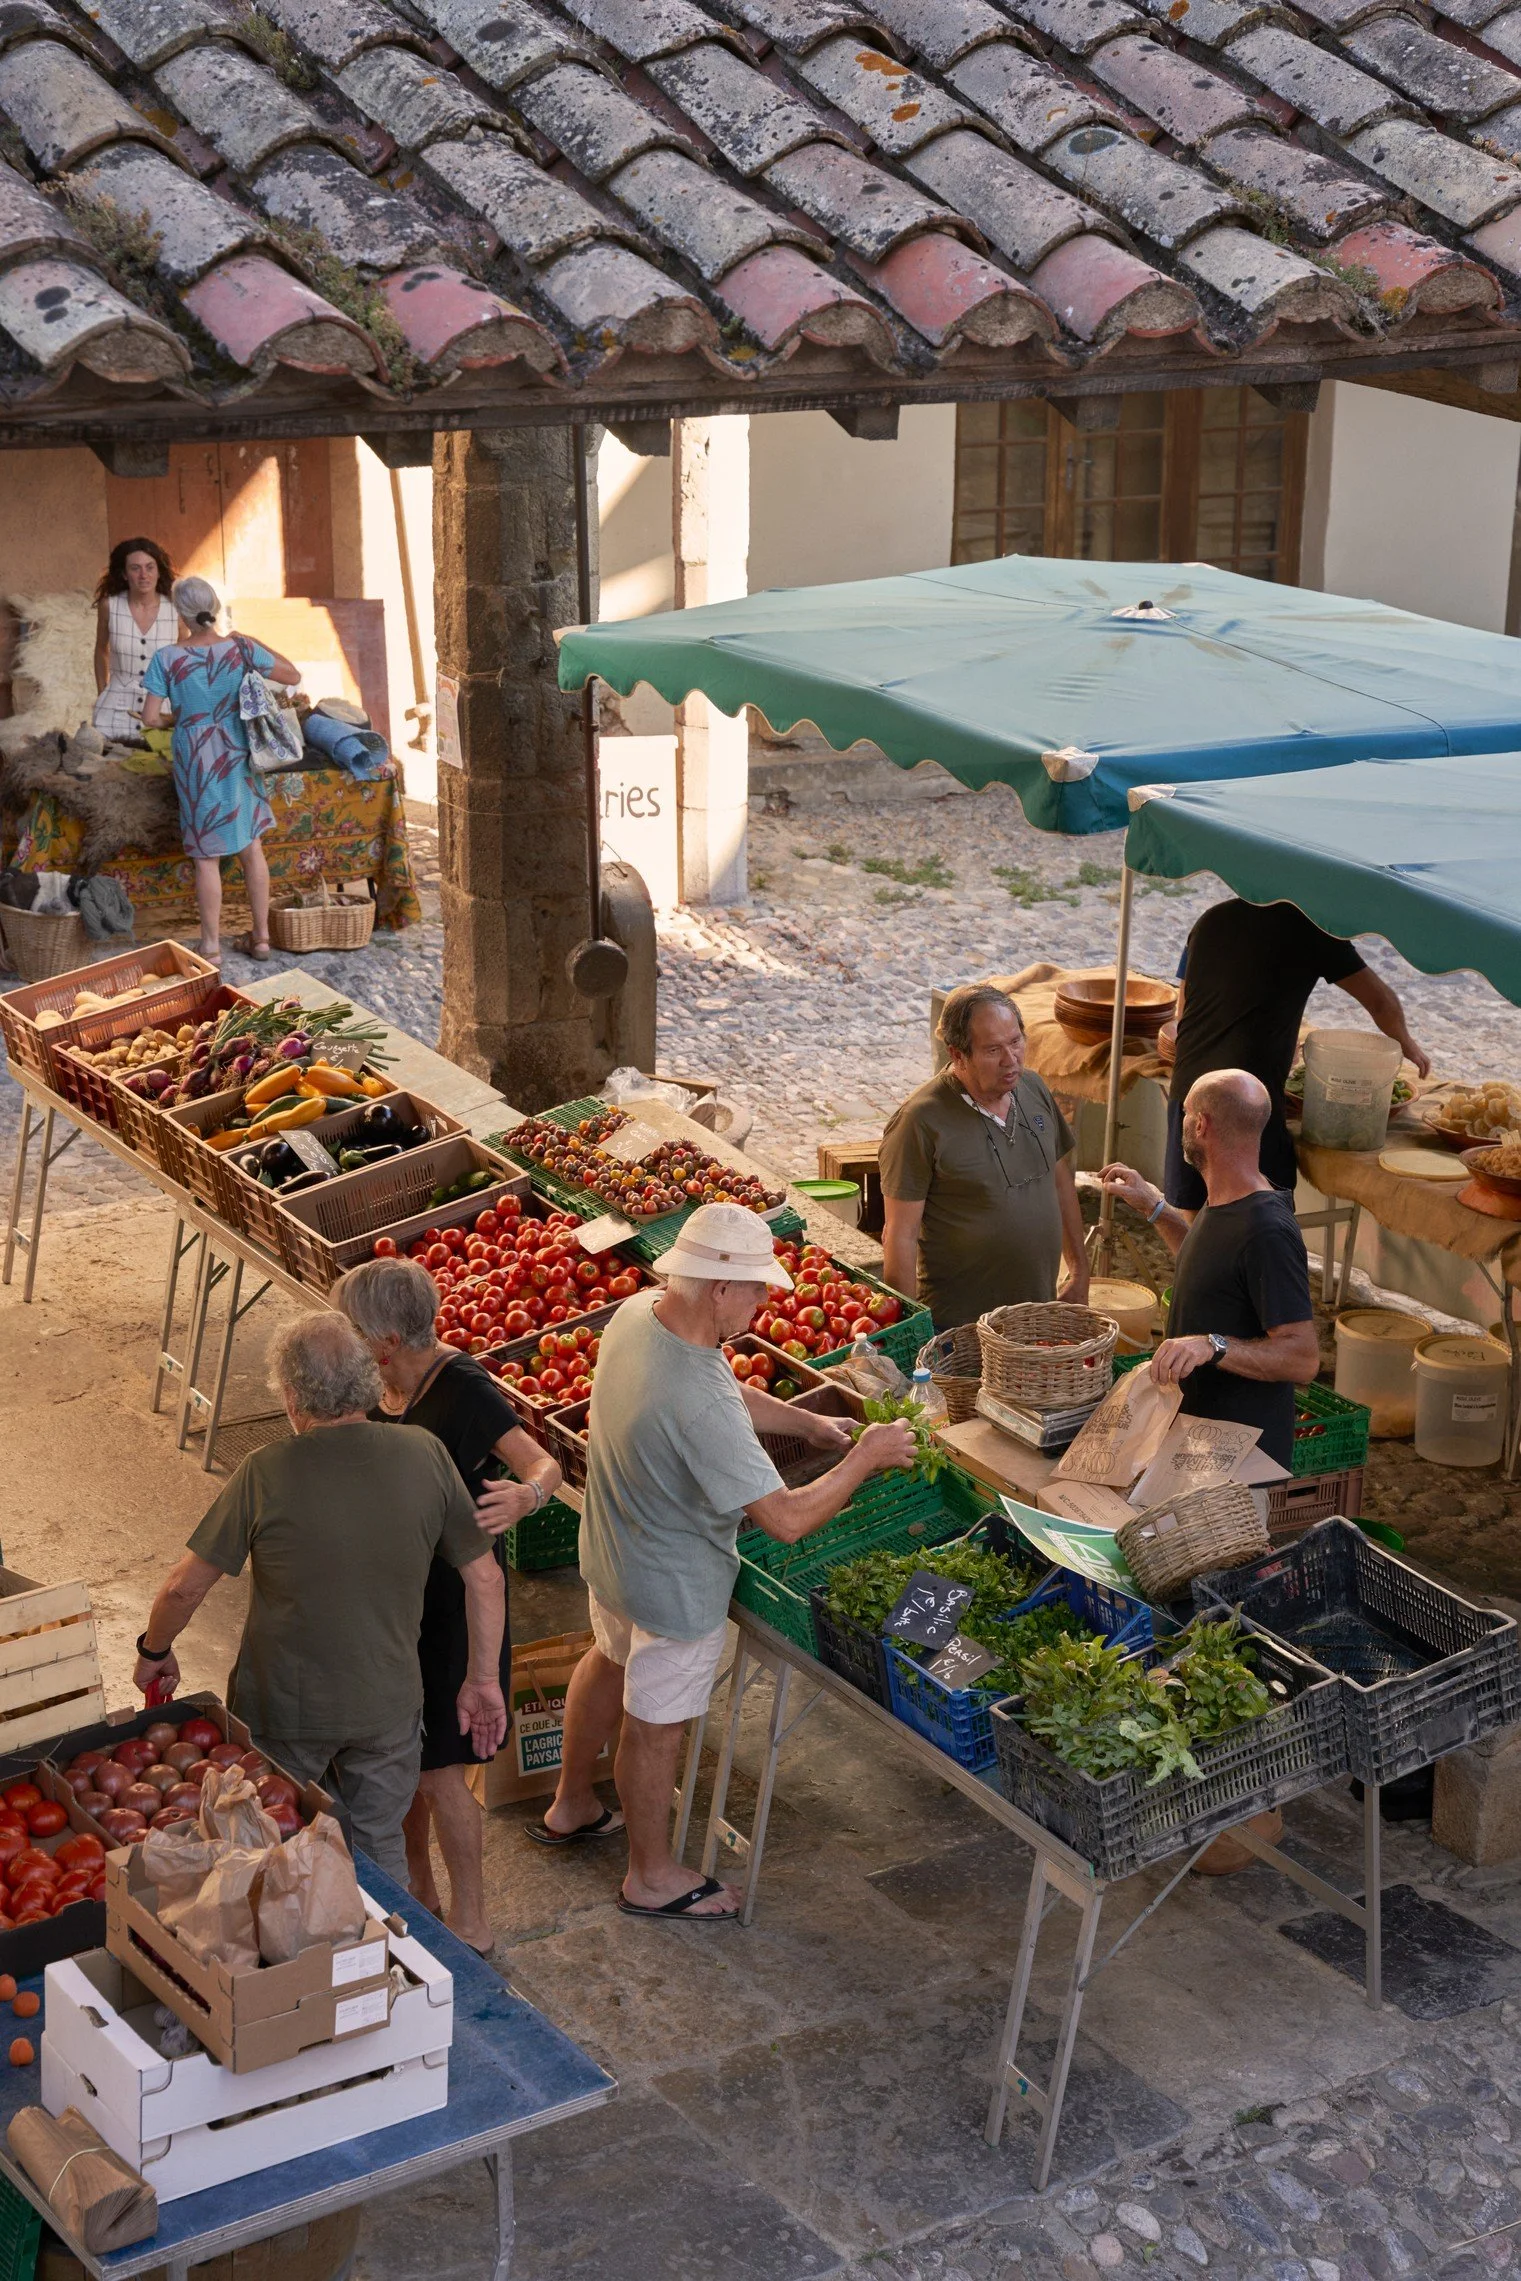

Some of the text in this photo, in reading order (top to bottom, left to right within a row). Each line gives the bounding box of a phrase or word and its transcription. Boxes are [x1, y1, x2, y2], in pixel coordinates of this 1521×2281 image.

[601, 782, 661, 819] ries
[926, 1588, 969, 1635] Basilic
[944, 1637, 983, 1666] Persil
[519, 1722, 531, 1734] CE
[532, 1719, 551, 1732] QUE
[524, 1734, 564, 1752] L'AGRIC
[526, 1748, 563, 1767] PAYSA
